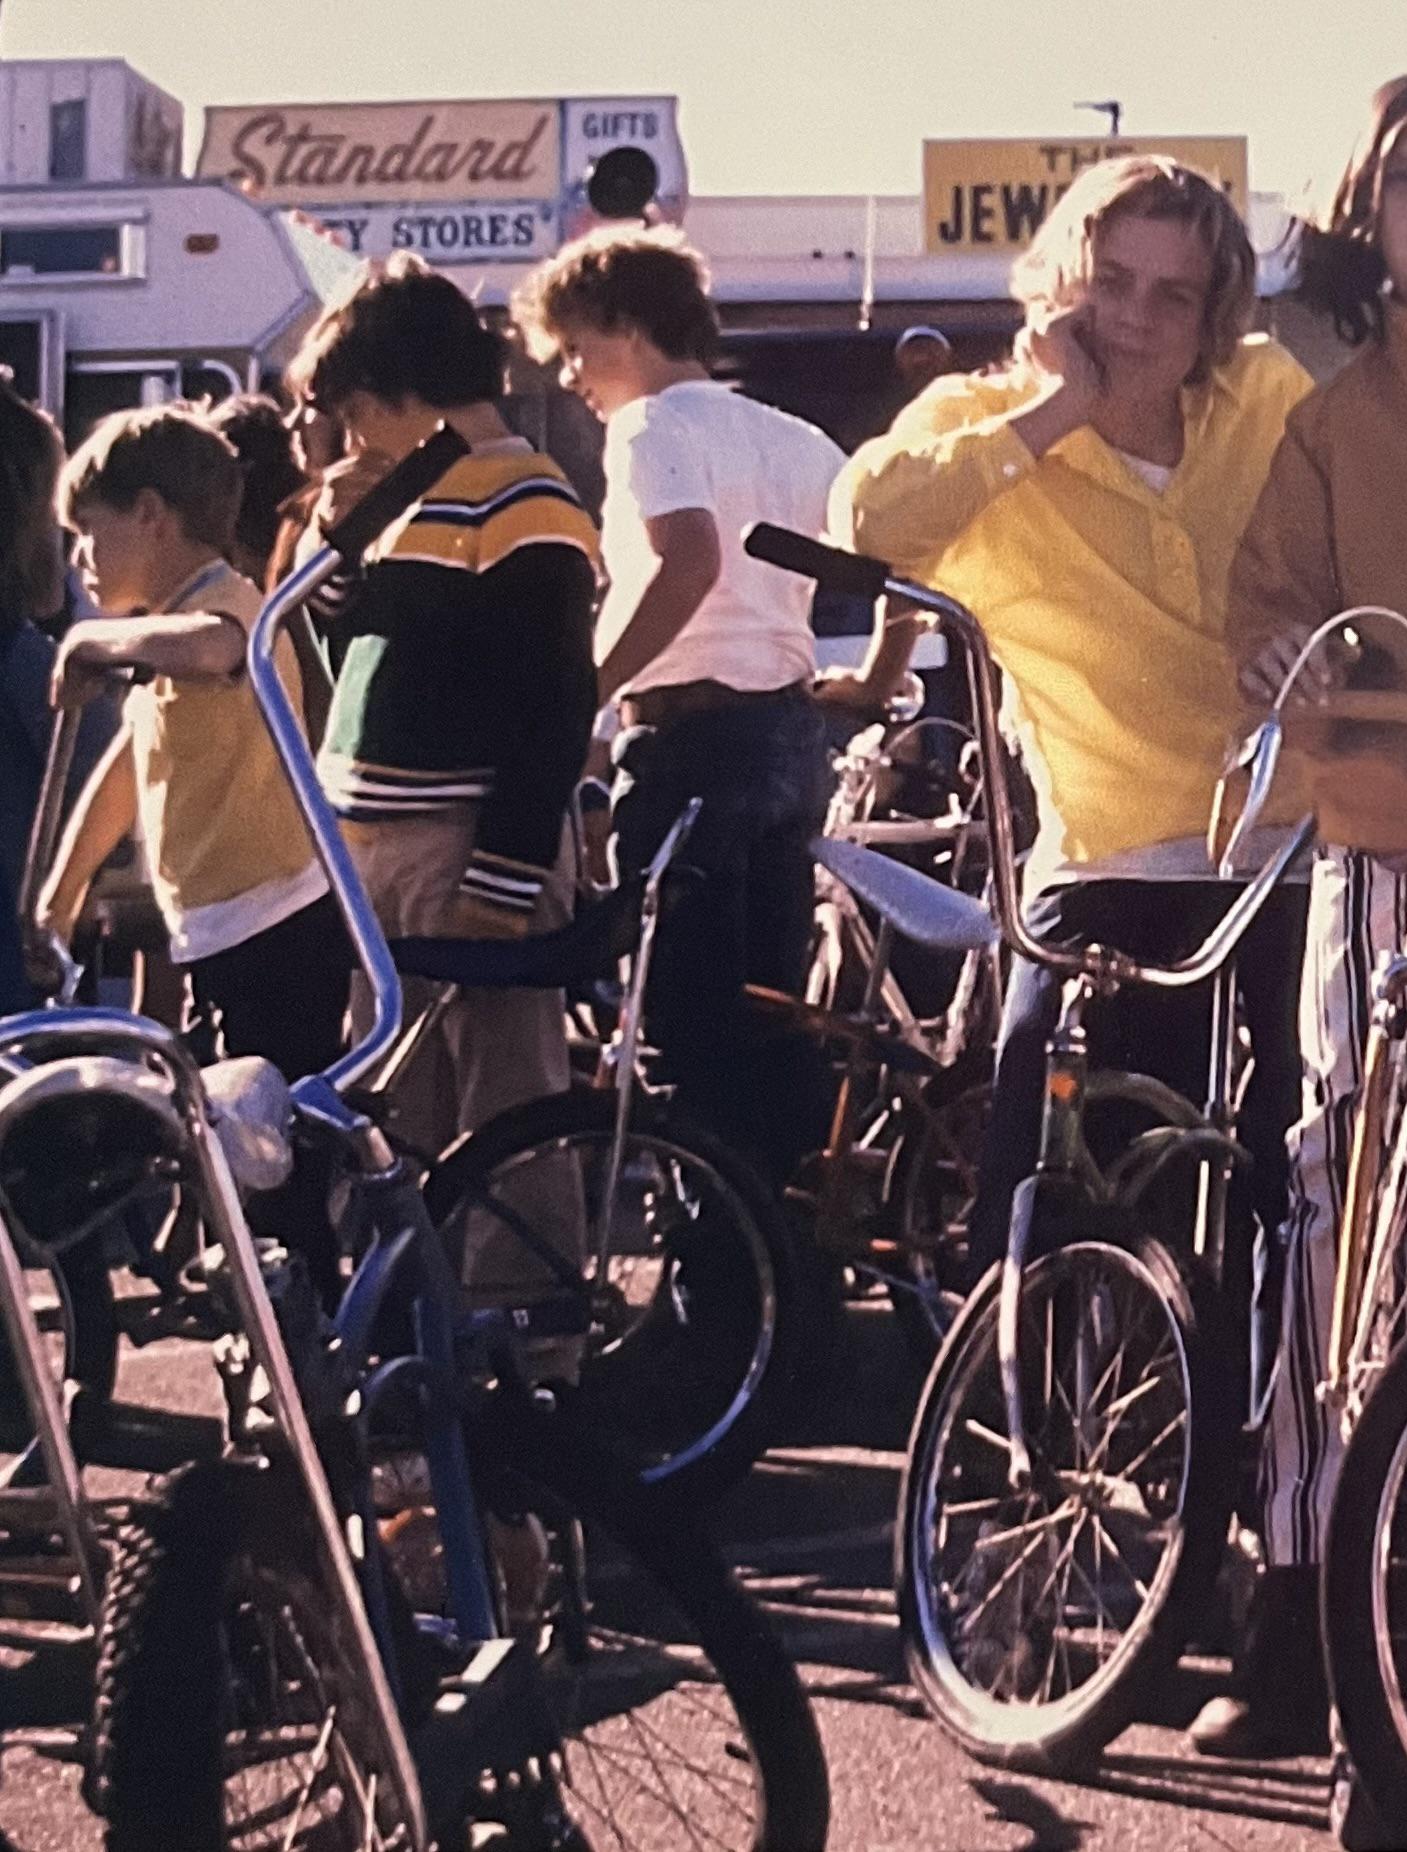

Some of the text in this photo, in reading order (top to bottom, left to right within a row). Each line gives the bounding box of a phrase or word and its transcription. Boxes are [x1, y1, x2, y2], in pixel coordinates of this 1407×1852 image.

[583, 111, 658, 139] GIFTS
[229, 112, 548, 188] Standard
[392, 213, 534, 249] STORES
